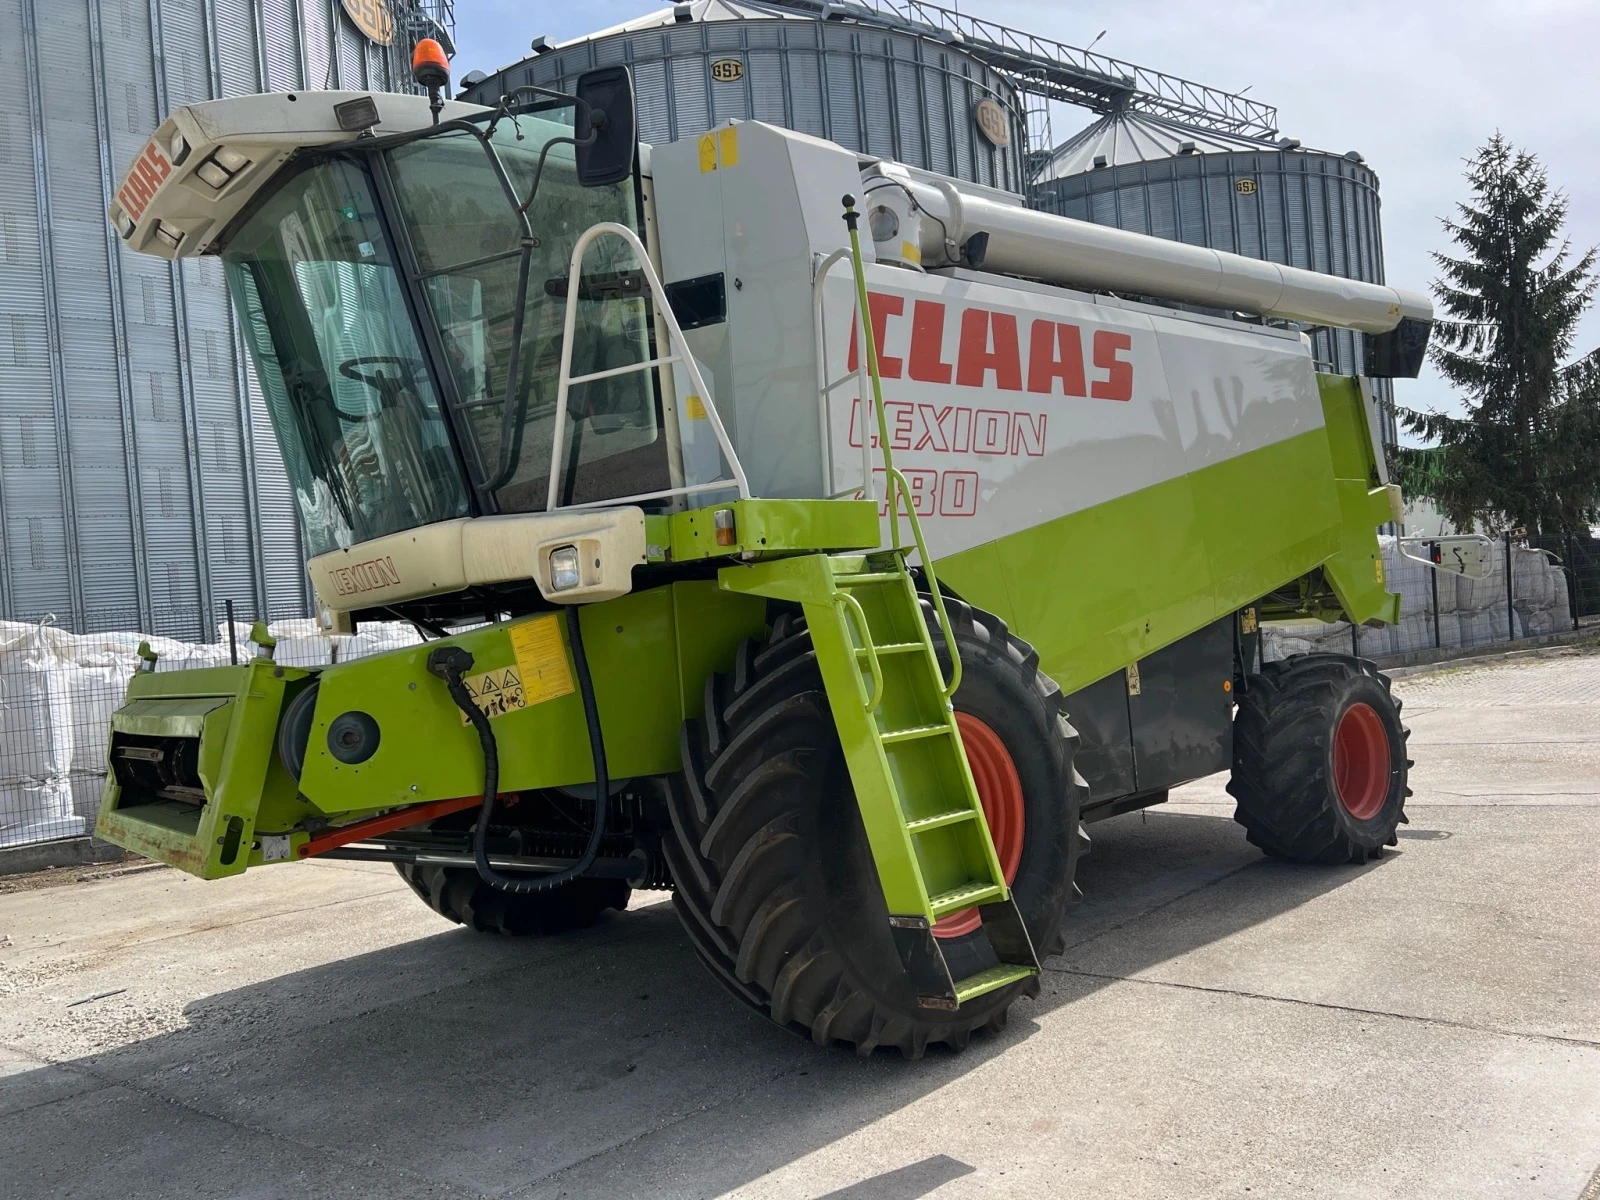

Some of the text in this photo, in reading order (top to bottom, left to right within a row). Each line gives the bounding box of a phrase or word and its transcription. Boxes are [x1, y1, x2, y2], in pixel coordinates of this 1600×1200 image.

[712, 63, 742, 77] GSI
[980, 106, 1007, 139] GSI
[118, 142, 172, 221] CLAAS
[1236, 181, 1256, 192] GSI
[847, 291, 1133, 402] CLAAS
[849, 398, 1047, 456] LEXION
[328, 555, 401, 596] LEXION
